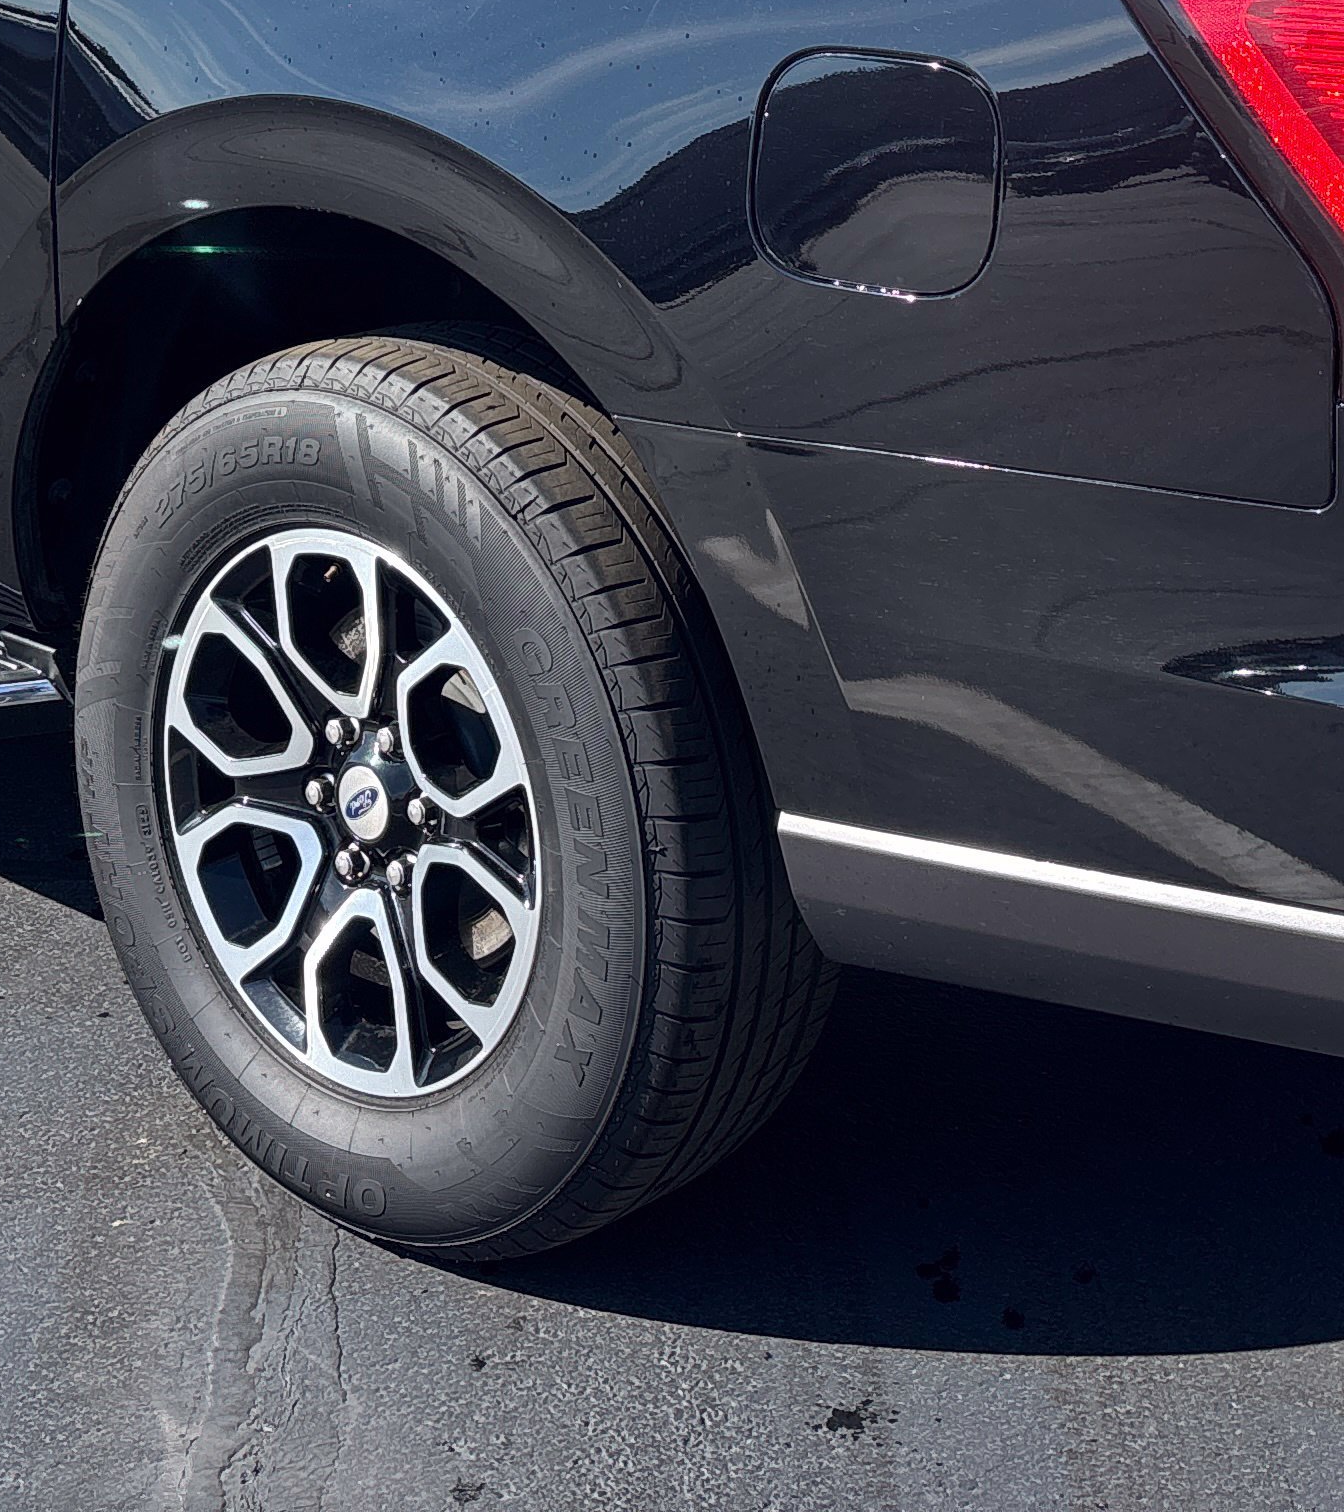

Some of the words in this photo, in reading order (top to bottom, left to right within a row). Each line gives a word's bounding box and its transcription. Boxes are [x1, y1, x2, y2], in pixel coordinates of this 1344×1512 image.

[155, 437, 322, 529] 275/65R18
[349, 790, 373, 816] Ford
[512, 627, 612, 1088] GREENMAX
[179, 1045, 388, 1217] OPTIMUM
